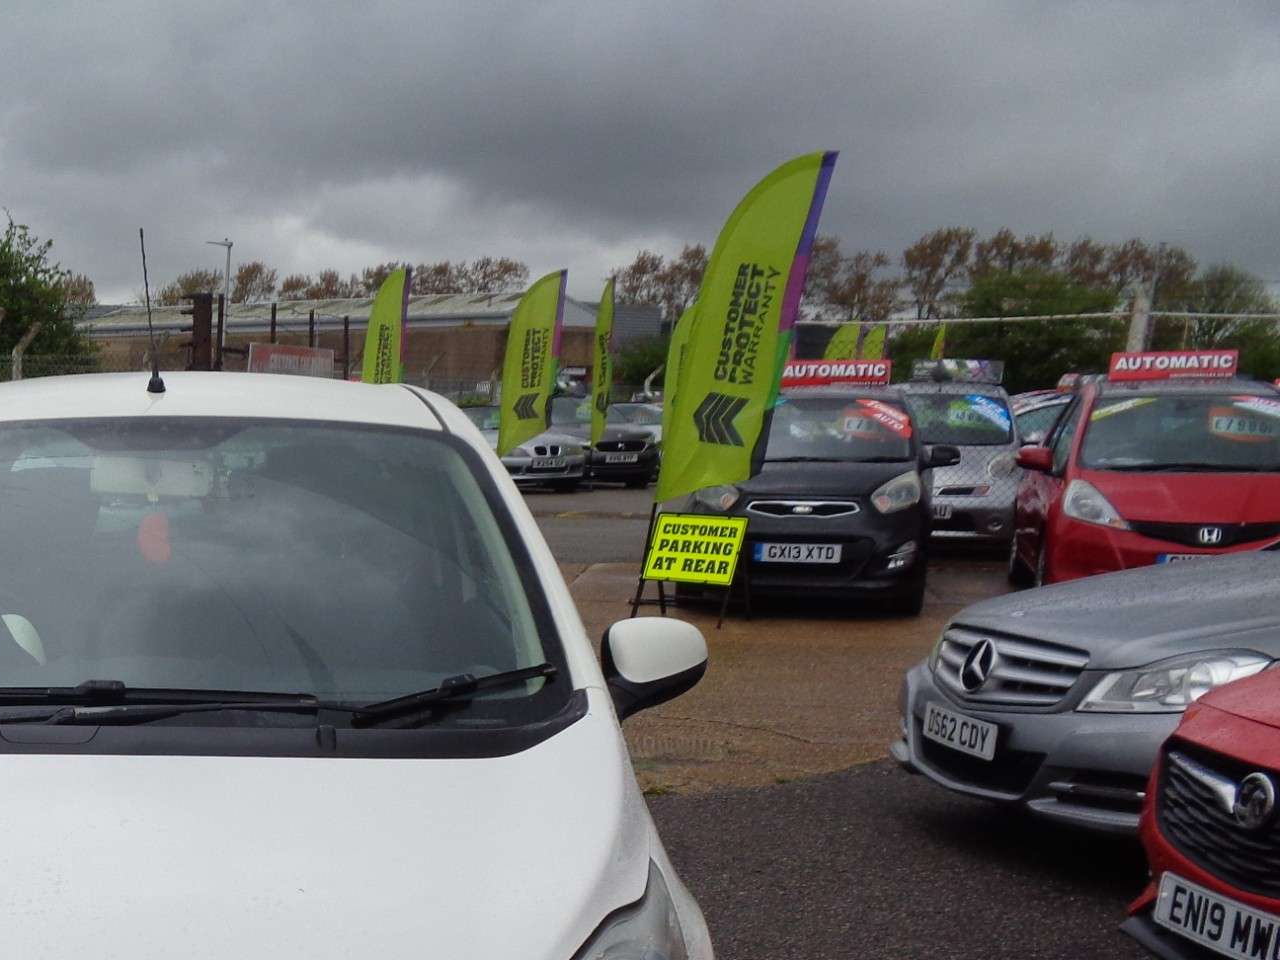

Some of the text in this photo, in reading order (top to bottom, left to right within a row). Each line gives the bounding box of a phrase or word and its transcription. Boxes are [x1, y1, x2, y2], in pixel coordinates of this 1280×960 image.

[714, 263, 750, 381] CUSTOMER
[728, 263, 764, 383] PROTECT
[739, 265, 781, 384] WARRANTY
[521, 329, 531, 388] CUSTOMER
[530, 328, 541, 388] PROTECT
[783, 363, 886, 377] AUTOMATIC
[1116, 354, 1233, 370] AUTOMATIC
[663, 523, 738, 538] CUSTOMER
[658, 539, 734, 556] PARKING
[768, 545, 835, 560] GX13 XTD
[652, 556, 729, 574] AT REAR
[960, 721, 990, 752] CDY
[1169, 885, 1226, 941] EN19
